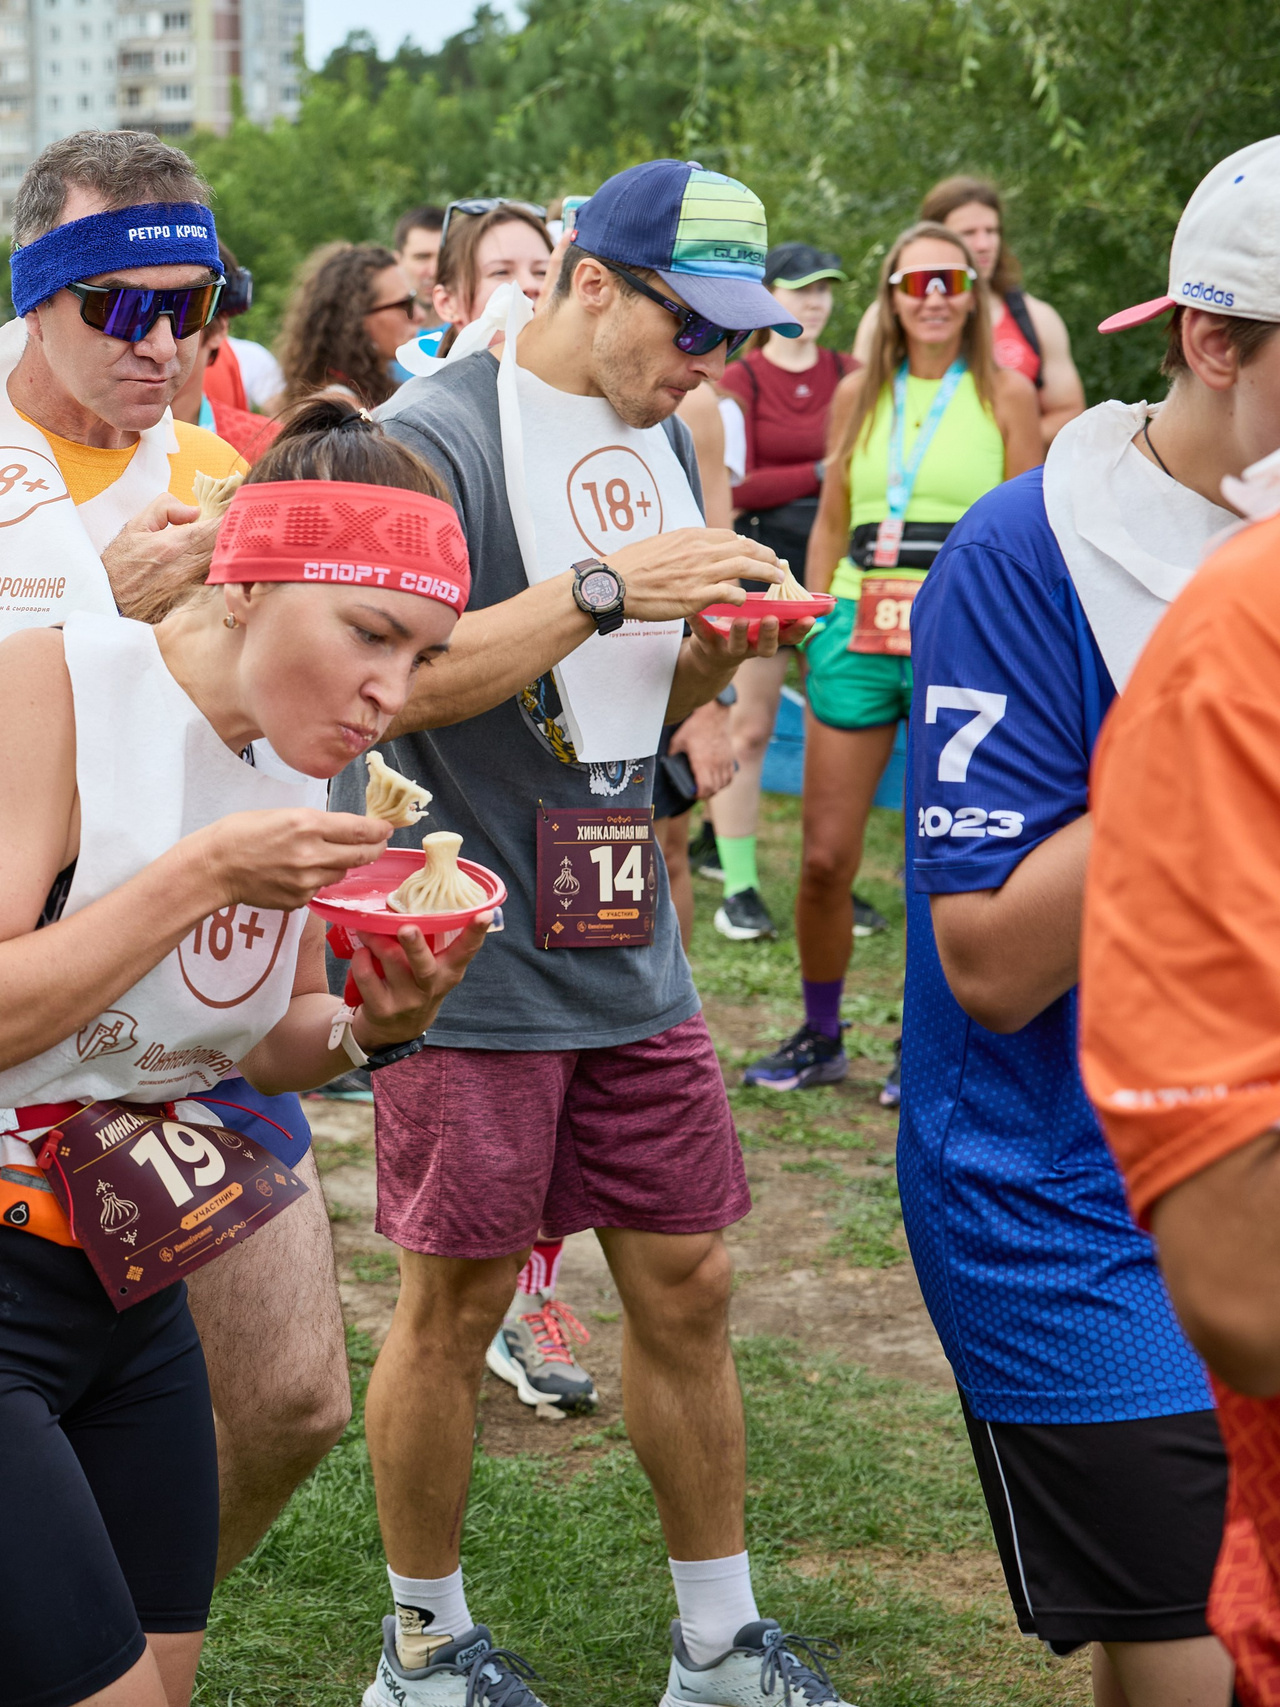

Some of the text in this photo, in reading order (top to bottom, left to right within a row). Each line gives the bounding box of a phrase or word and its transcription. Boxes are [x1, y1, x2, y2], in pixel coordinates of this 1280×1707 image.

[128, 224, 208, 242] РЕТРО КРОСС
[1182, 281, 1235, 307] adidas
[581, 478, 652, 532] 18+
[303, 562, 461, 604] СПОРТ СОЮЗ
[12, 605, 51, 613] сыроварня
[925, 684, 1008, 783] 7
[577, 825, 635, 840] ХИНКАЛЬНАЯ
[589, 844, 645, 902] 14
[129, 1121, 226, 1208] 19
[192, 1189, 235, 1222] УЧАСТНИК
[459, 1643, 487, 1665] HOKA
[380, 1661, 407, 1707] HOKA
